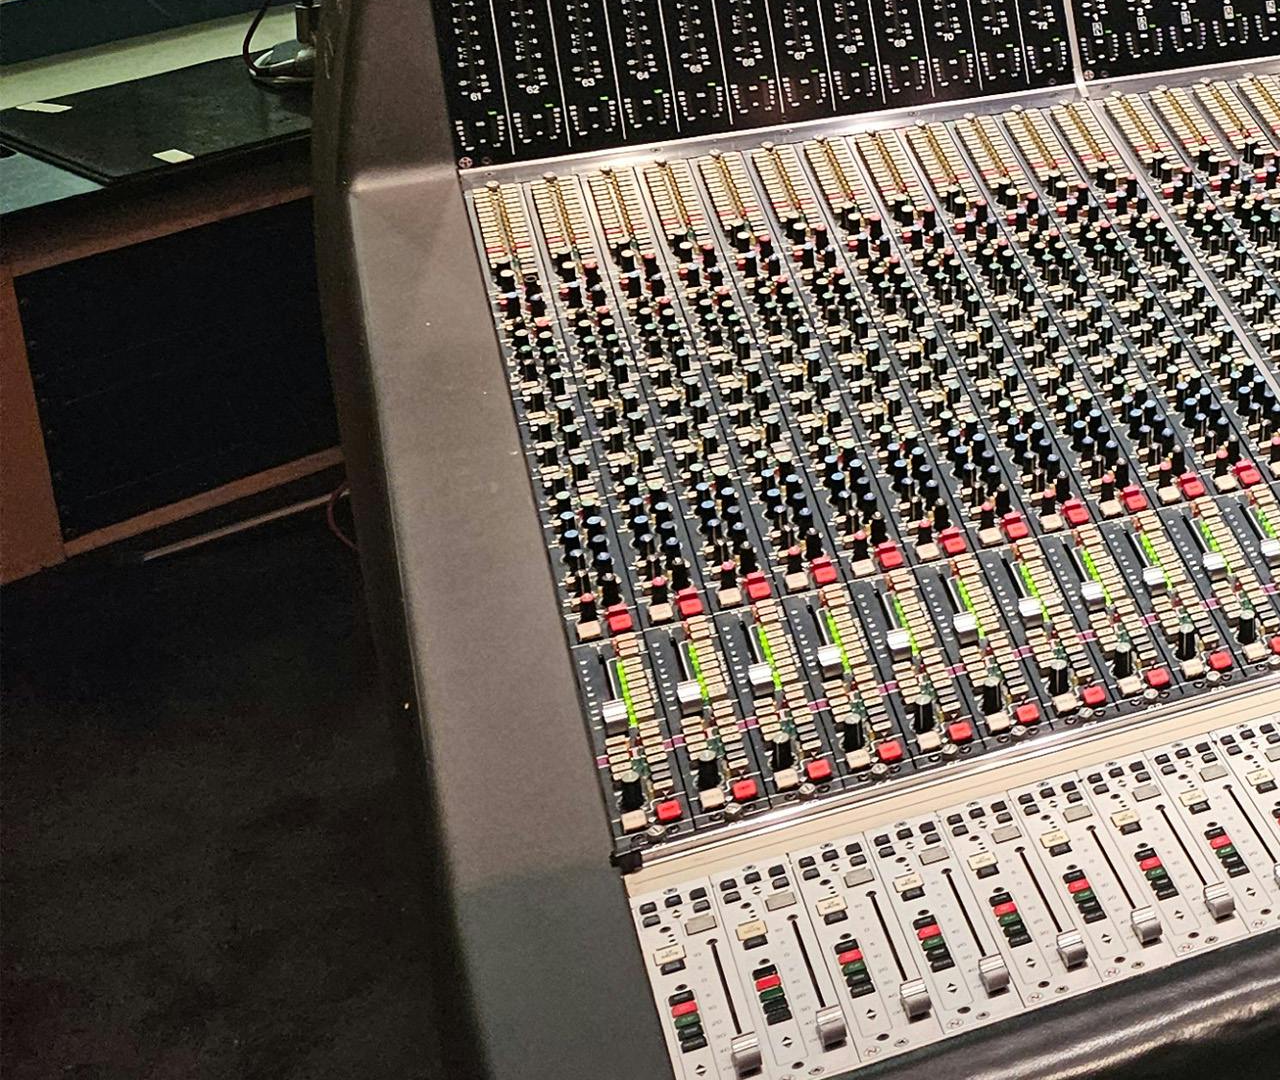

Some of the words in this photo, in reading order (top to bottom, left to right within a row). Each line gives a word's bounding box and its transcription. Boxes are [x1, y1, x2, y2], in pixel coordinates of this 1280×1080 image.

[470, 92, 482, 101] 61
[526, 85, 540, 94] 62
[582, 78, 596, 87] 63
[637, 71, 650, 80] 64
[794, 52, 806, 60] 67
[943, 33, 955, 42] 70
[991, 27, 1001, 35] 71
[1037, 21, 1049, 30] 72
